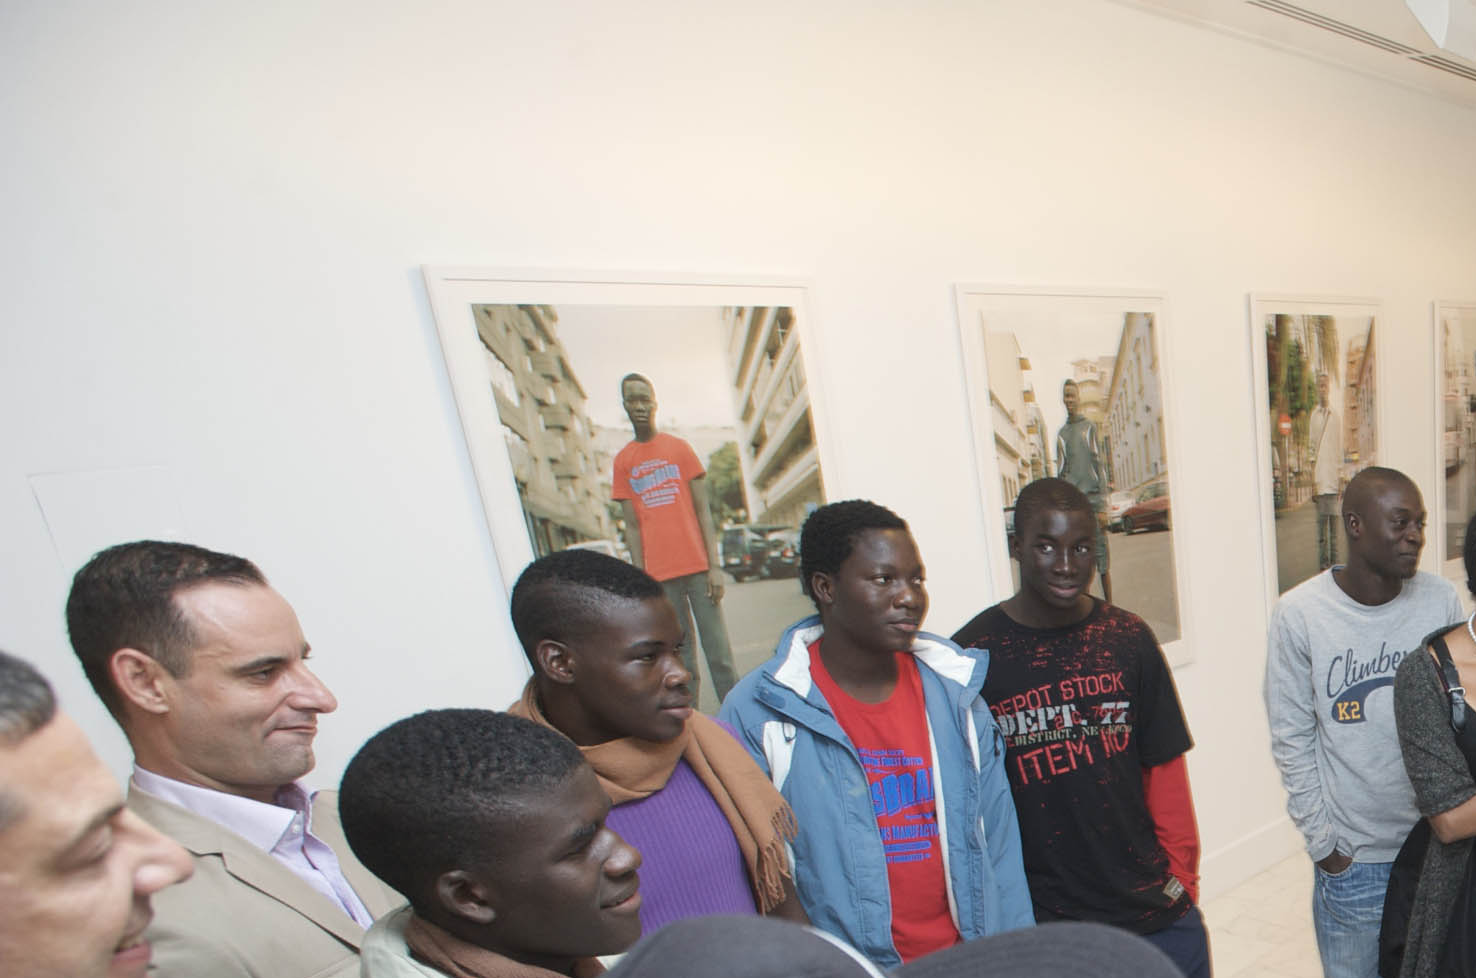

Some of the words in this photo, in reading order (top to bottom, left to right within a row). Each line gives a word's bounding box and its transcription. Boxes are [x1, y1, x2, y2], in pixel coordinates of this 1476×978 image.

[1327, 641, 1407, 698] Climbe
[1059, 671, 1125, 701] STOCK
[1100, 701, 1130, 724] 77
[1336, 701, 1361, 720] K2
[1017, 737, 1094, 785] ITEM
